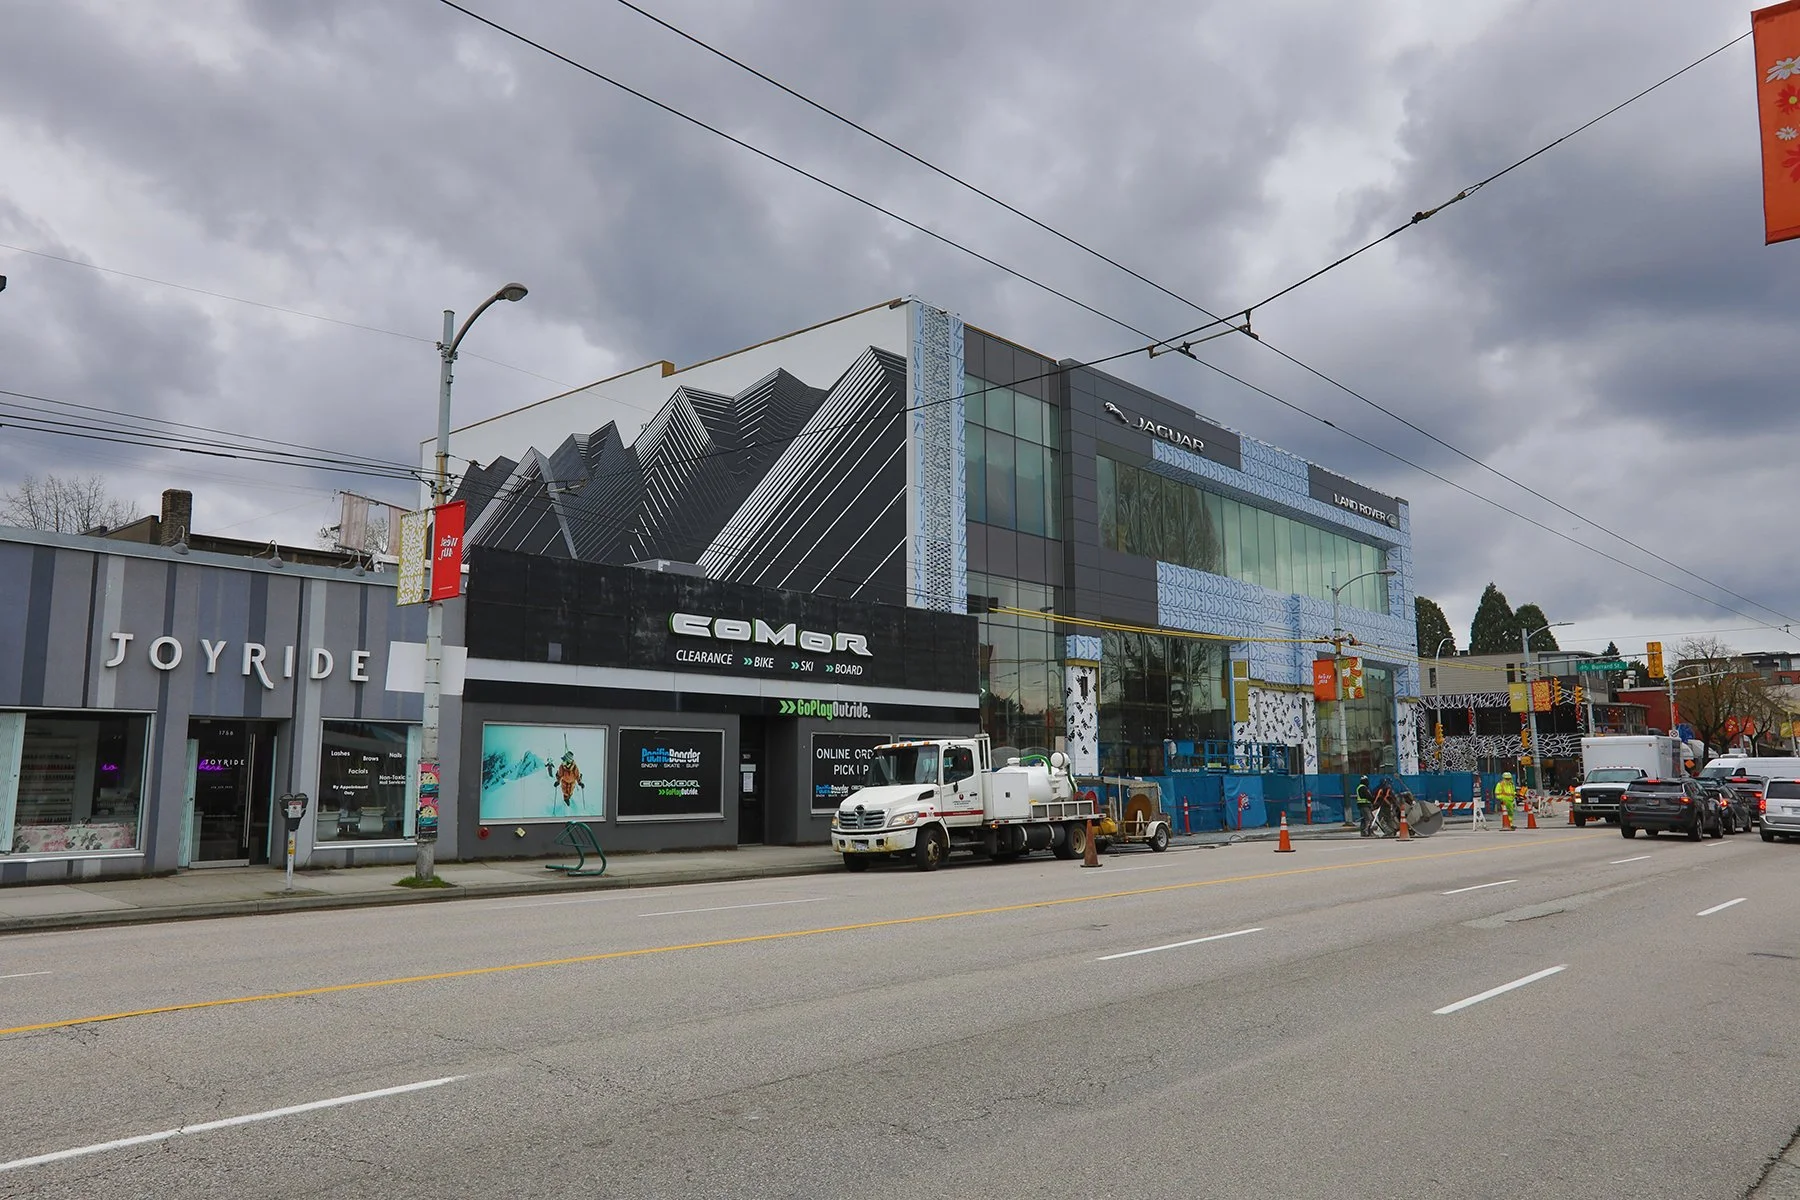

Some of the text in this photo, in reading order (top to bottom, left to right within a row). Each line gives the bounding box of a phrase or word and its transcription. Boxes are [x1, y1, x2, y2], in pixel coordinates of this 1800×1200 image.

[1131, 417, 1204, 452] JAGUAR
[1333, 493, 1386, 521] LAND ROVER
[105, 632, 371, 690] JOYRIDE
[676, 650, 863, 676] CLEARANCE BIKE SKI BOARD
[205, 759, 245, 767] JOYRIDE
[816, 748, 850, 760] ONLINE
[834, 764, 854, 775] PICK
